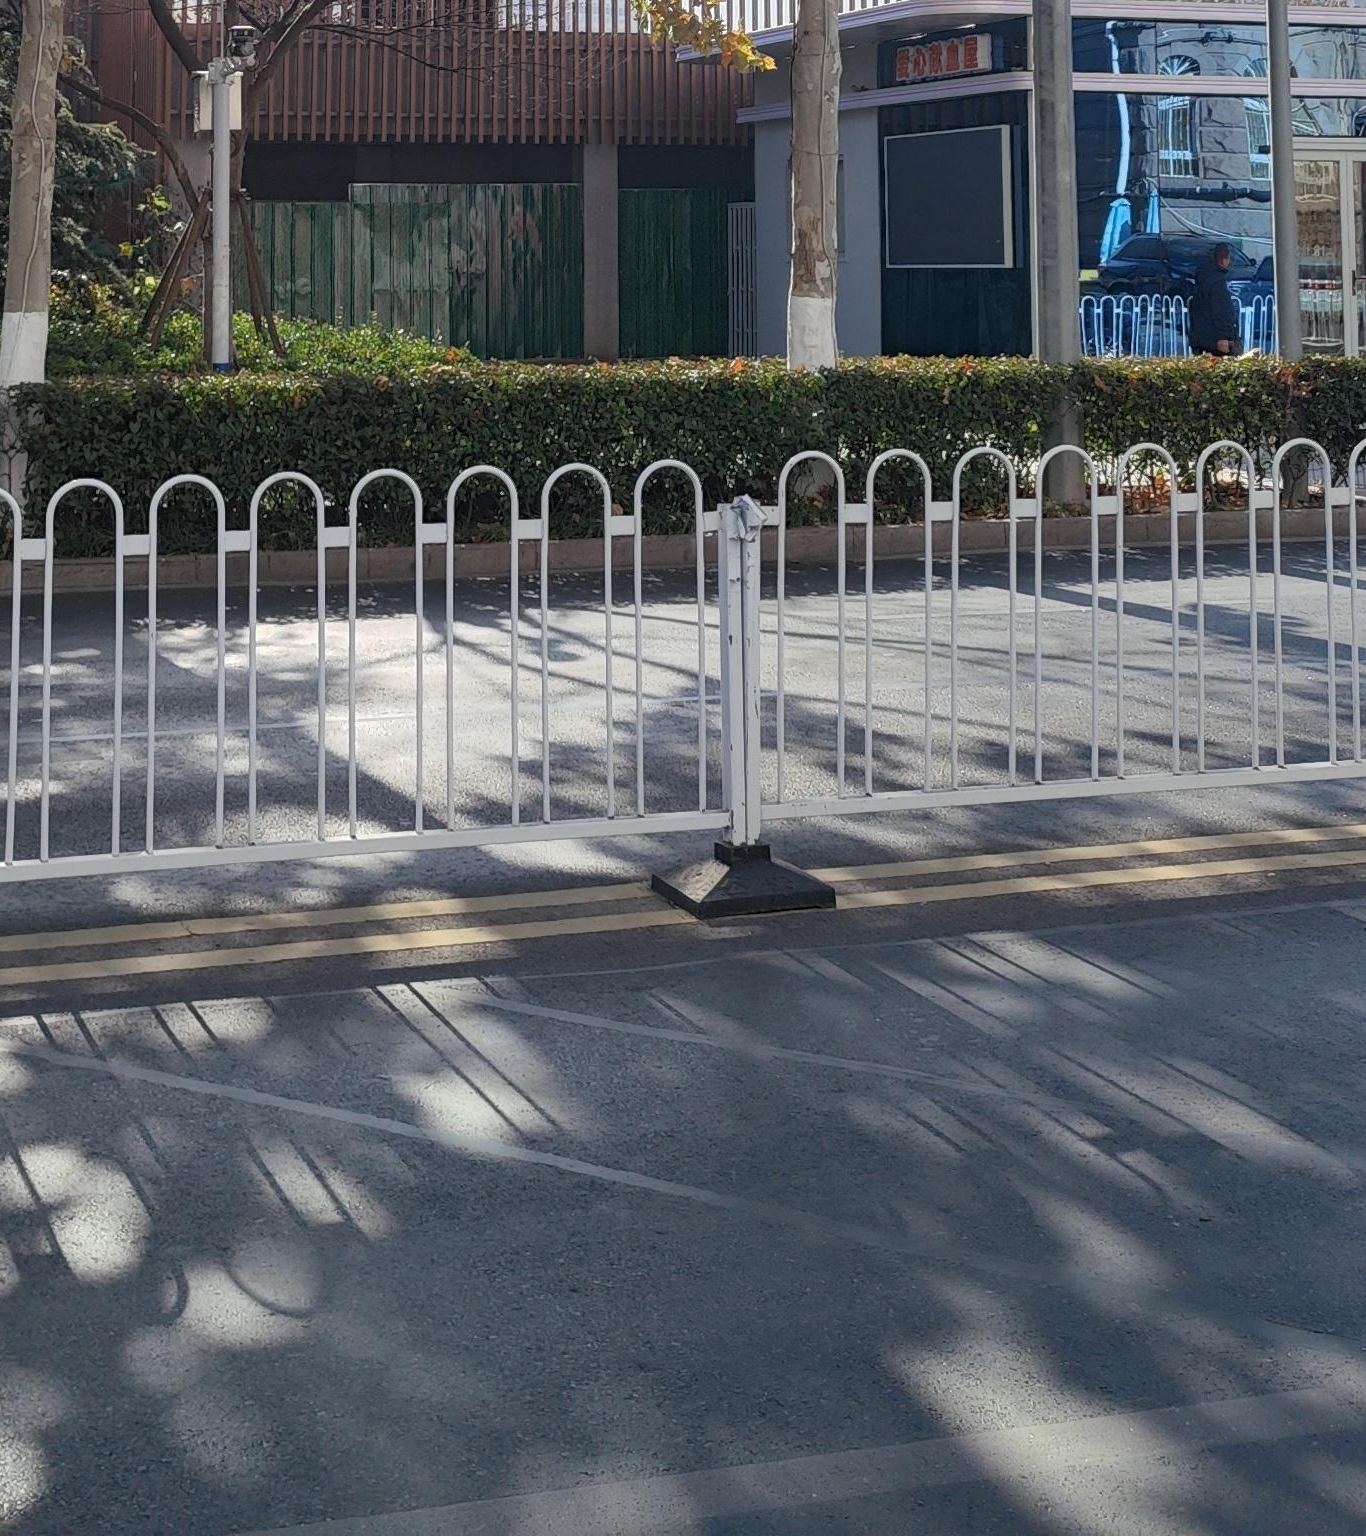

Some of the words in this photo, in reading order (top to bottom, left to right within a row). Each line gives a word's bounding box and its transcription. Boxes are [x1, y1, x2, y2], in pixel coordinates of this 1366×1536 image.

[897, 36, 979, 79] 爱心献血屋
